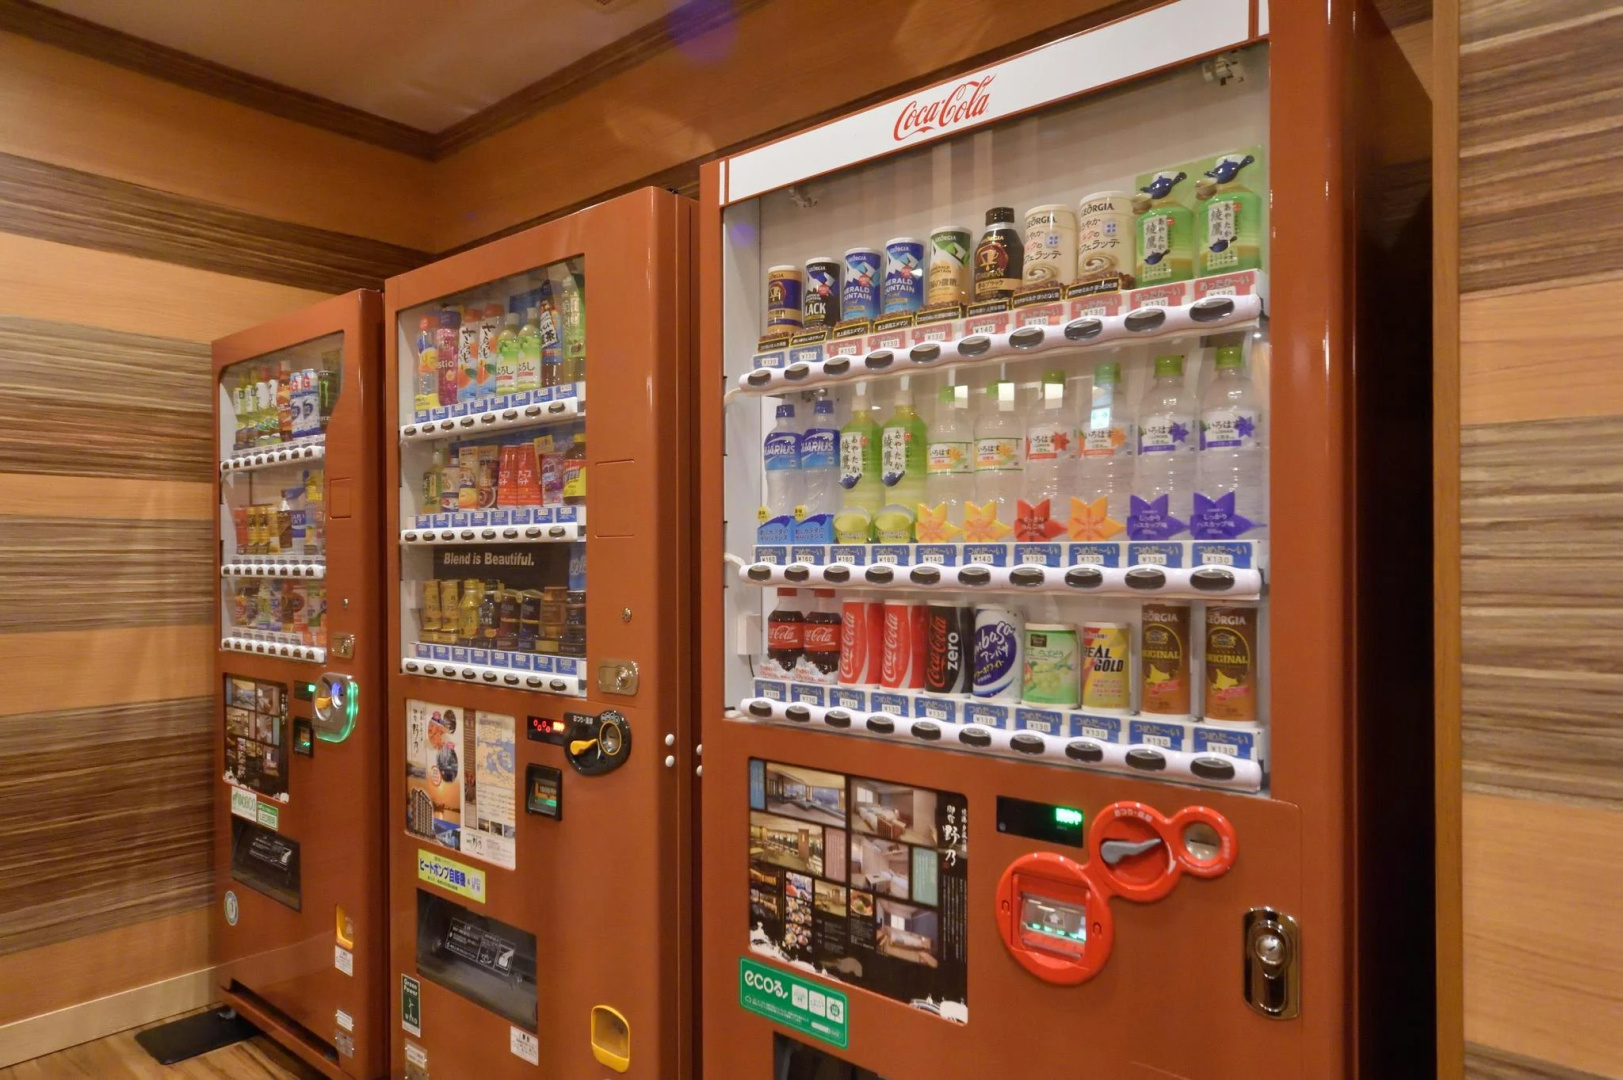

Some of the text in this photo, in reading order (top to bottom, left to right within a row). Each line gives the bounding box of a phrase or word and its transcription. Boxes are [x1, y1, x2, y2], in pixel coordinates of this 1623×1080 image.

[894, 73, 996, 141] Coca-Cola
[974, 326, 994, 334] ¥140
[444, 552, 535, 567] Blend is Beautiful.
[1025, 555, 1044, 563] ¥130
[1142, 556, 1164, 564] ¥130
[1206, 556, 1230, 564] ¥130
[947, 632, 959, 671] zero
[1094, 659, 1124, 673] GOLD
[976, 717, 995, 725] ¥130
[1029, 722, 1049, 731] ¥130
[1084, 729, 1106, 738] ¥130
[1145, 737, 1169, 746] ¥130
[1210, 745, 1236, 754] ¥130
[403, 978, 418, 989] Green
[403, 985, 418, 997] Power
